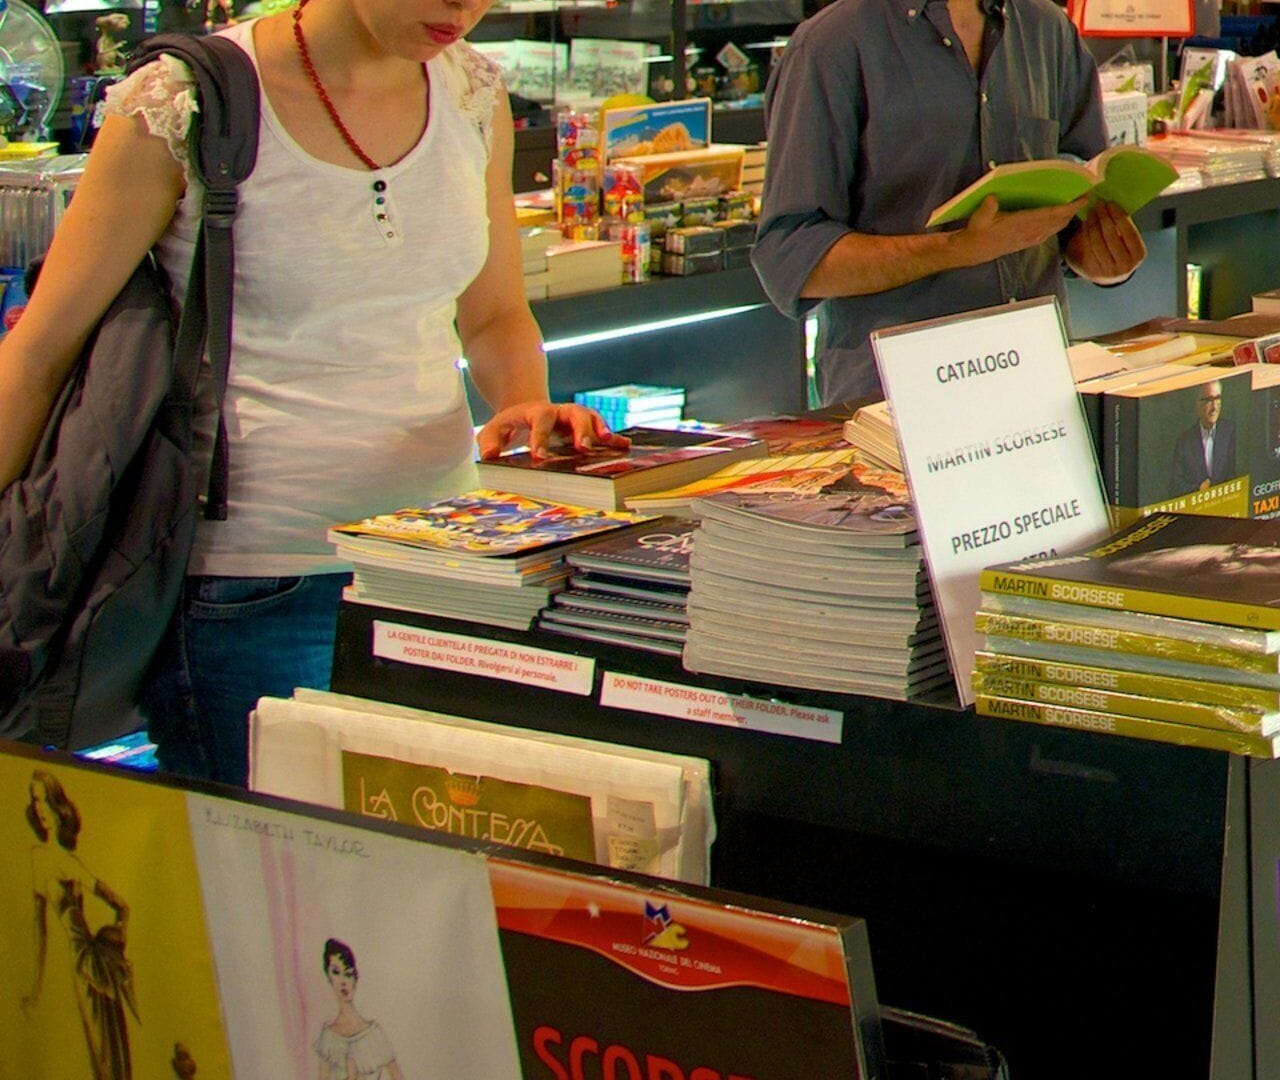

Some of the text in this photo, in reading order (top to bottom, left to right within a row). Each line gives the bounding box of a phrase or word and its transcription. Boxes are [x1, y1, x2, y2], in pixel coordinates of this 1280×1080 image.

[936, 349, 1020, 385] CATALOGO
[926, 420, 1067, 474] MARTIN SCORSESE
[1191, 481, 1242, 506] SCORSESE
[1253, 498, 1279, 516] TAXI
[951, 499, 1081, 555] PREZZO SPECIALE
[994, 576, 1125, 607] MARTIN SCORSESE
[387, 629, 398, 640] LA
[398, 631, 427, 646] GENTILE
[427, 637, 467, 652] CLIENTELA
[474, 644, 509, 659] PREGATA
[510, 650, 518, 660] DI
[519, 651, 536, 664] NON
[536, 654, 574, 671] ESTRARRE
[1044, 624, 1118, 649] SCORSESE
[403, 646, 431, 660] POSTER
[431, 650, 445, 663] DAI
[446, 652, 477, 667] FOLDER.
[1046, 665, 1119, 688] SCORSESE
[613, 677, 830, 724] DO NOT TAKE POSTERS OUT OF THEIR FOLDER. Please ask
[692, 706, 713, 720] staff
[1039, 686, 1108, 709] SCORSESE
[988, 700, 1116, 732] MARTIN SCORSESE
[360, 776, 398, 822] LA
[302, 829, 371, 858] TAYLOR
[611, 941, 722, 975] MUSEO NAZIONALE DEL CINEMA
